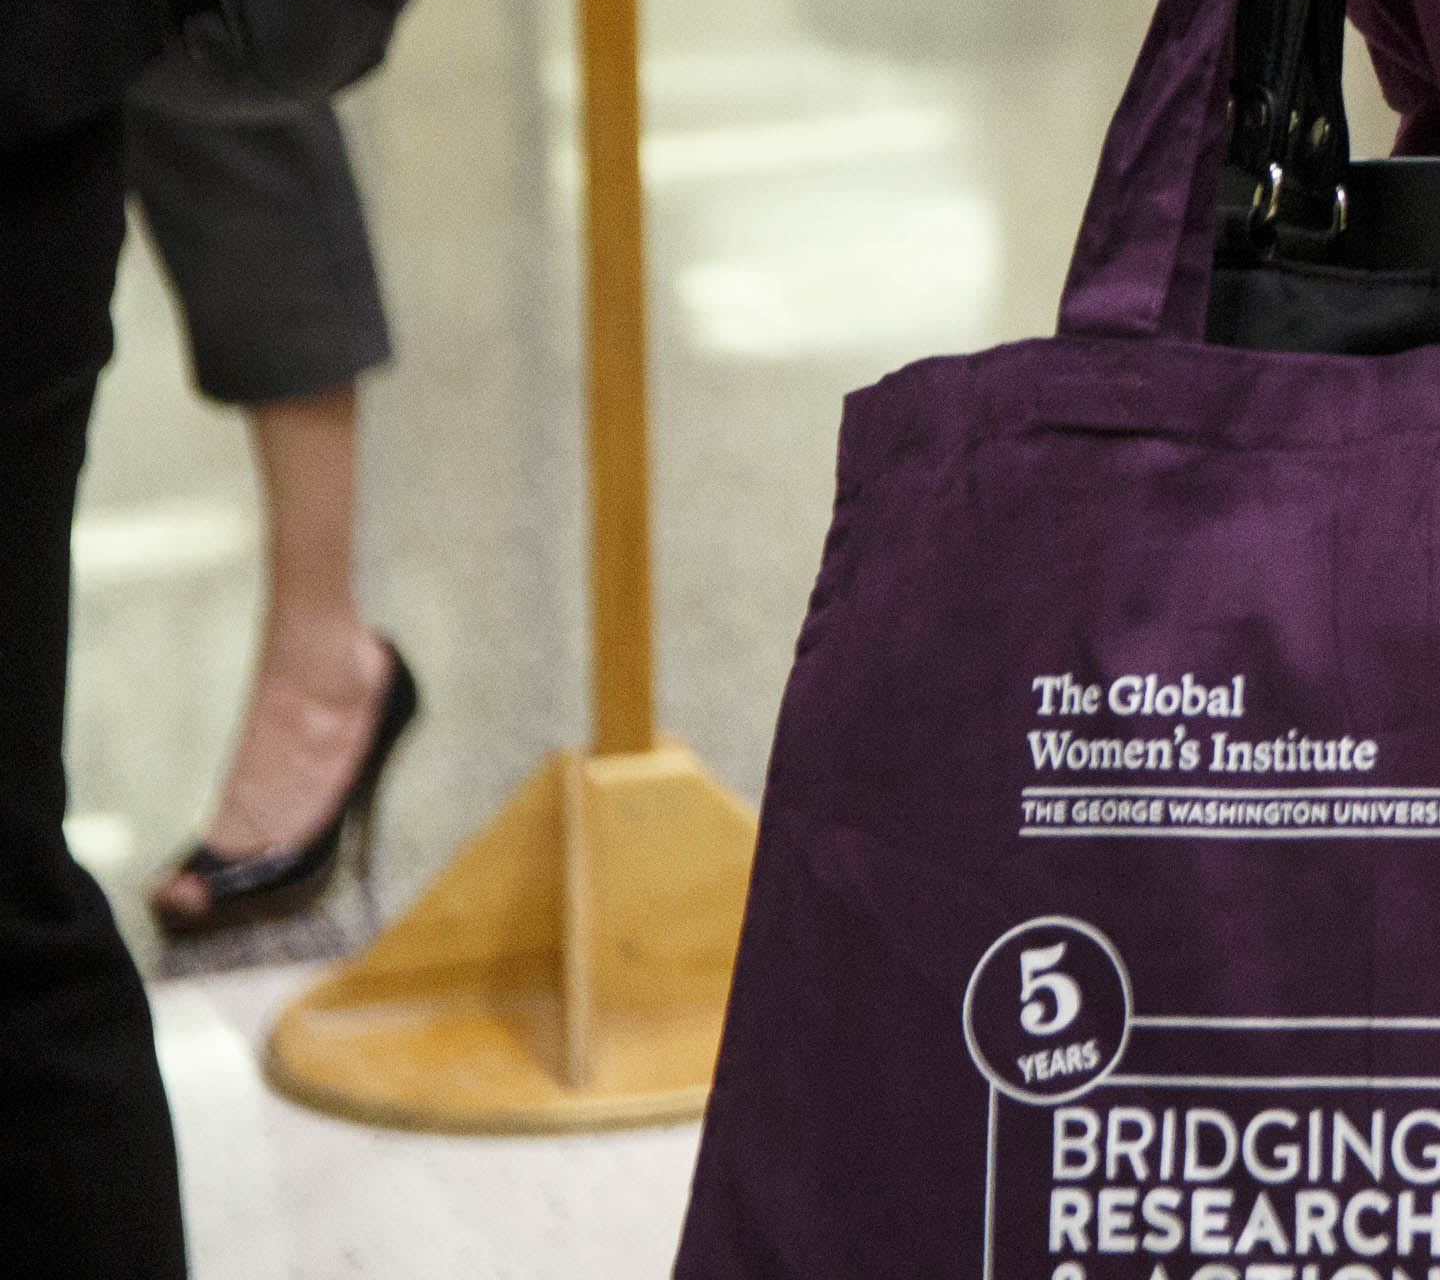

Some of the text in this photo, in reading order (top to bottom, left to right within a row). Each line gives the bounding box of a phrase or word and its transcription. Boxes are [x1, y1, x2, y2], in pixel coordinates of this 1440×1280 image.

[1032, 672, 1246, 718] The Global
[1026, 725, 1380, 773] Women's Institute
[1021, 799, 1066, 824] THE
[1071, 799, 1165, 824] GEORGE
[1168, 800, 1329, 826] WASHINGTON
[1019, 941, 1082, 1037] 5
[1017, 1039, 1100, 1083] YEARS
